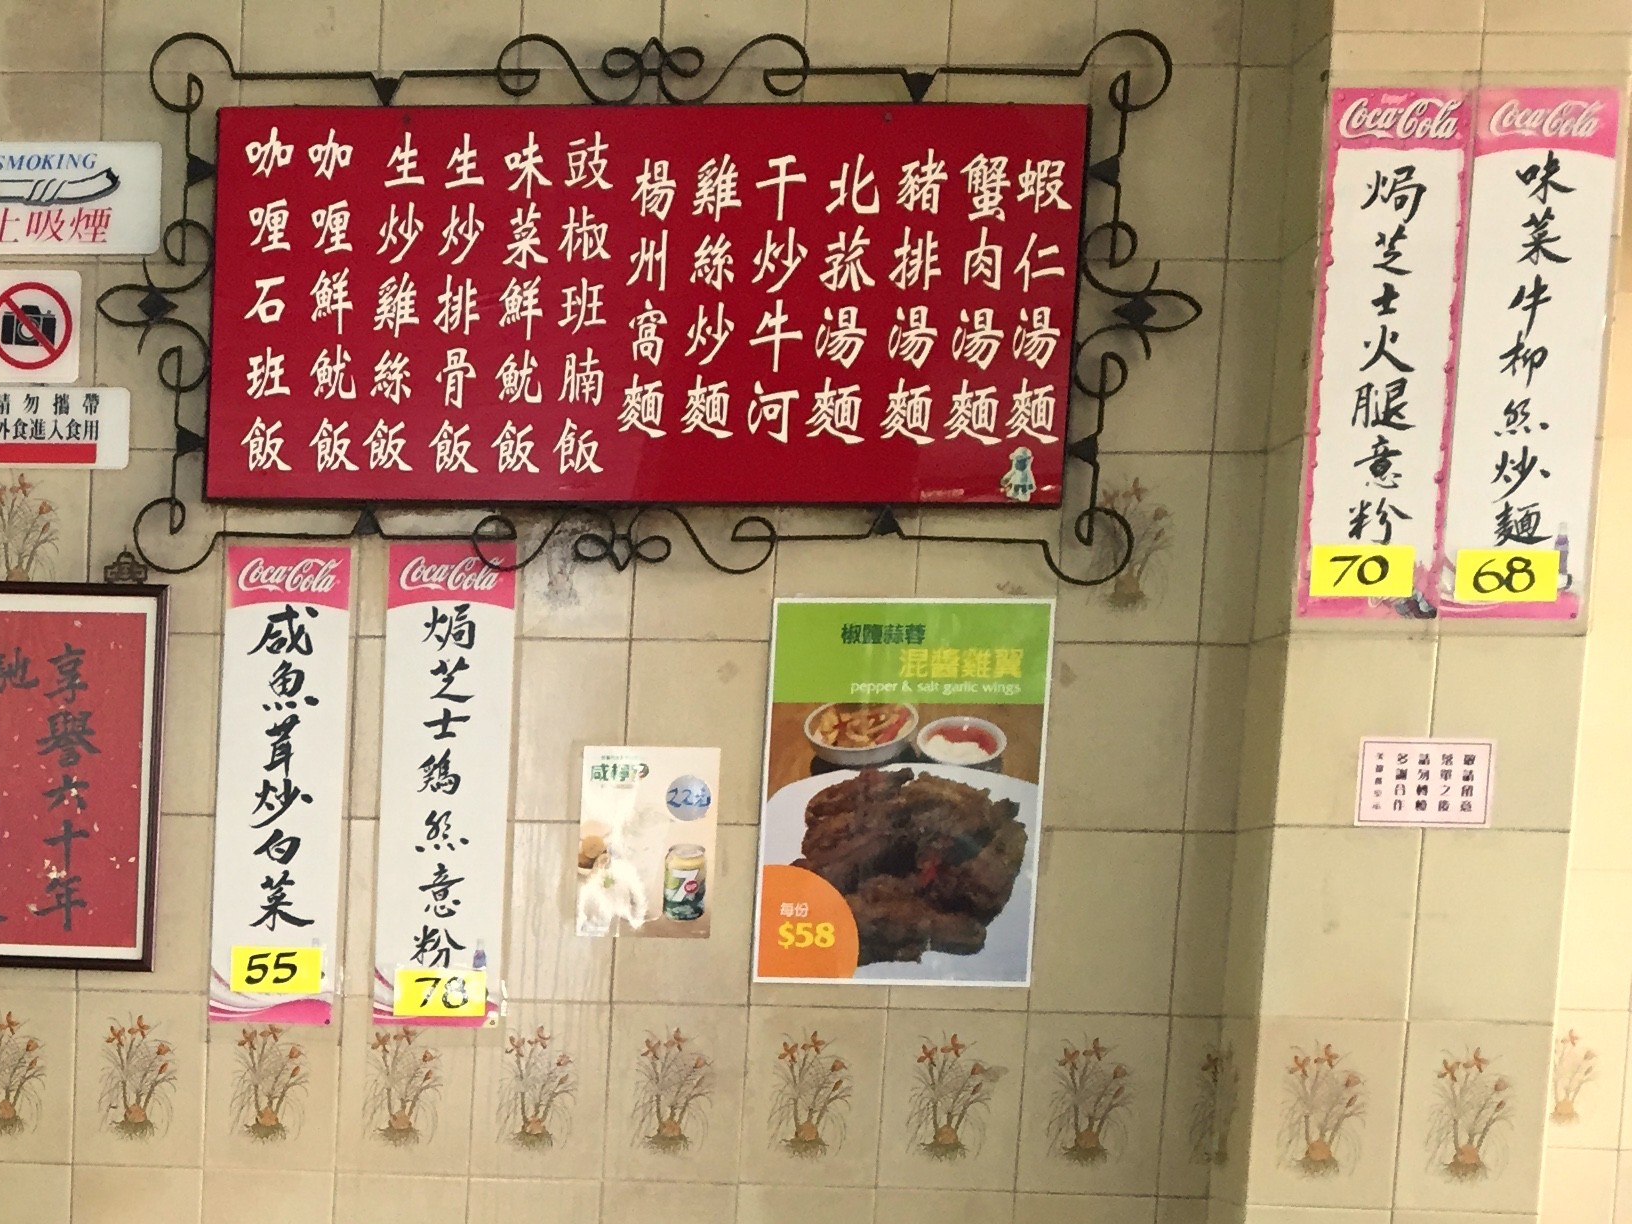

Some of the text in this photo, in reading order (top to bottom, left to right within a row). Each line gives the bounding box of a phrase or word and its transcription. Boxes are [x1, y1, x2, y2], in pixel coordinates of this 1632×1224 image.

[1338, 97, 1464, 141] Coca-Cola
[1488, 100, 1604, 140] Coca-Cola
[429, 133, 484, 473] 生炒排骨飯
[491, 132, 552, 473] 味菜鮮魷飯
[617, 159, 676, 438] 楊州窩麵
[748, 155, 808, 443] 干炒牛河
[880, 149, 948, 444] 豬排湯麵
[944, 153, 1011, 445] 蟹肉湯麵
[1005, 159, 1072, 445] 蝦仁湯麵
[1348, 165, 1428, 545] 焗芝士火腿意粉
[238, 556, 344, 594] Coca-Cola
[399, 556, 505, 594] Coca-Cola
[1329, 555, 1390, 586] 70
[1473, 555, 1536, 594] 68
[850, 680, 1021, 696] pepper & salt garlic wings
[778, 920, 837, 950] $58
[243, 951, 299, 985] 55
[414, 975, 469, 1010] 78
